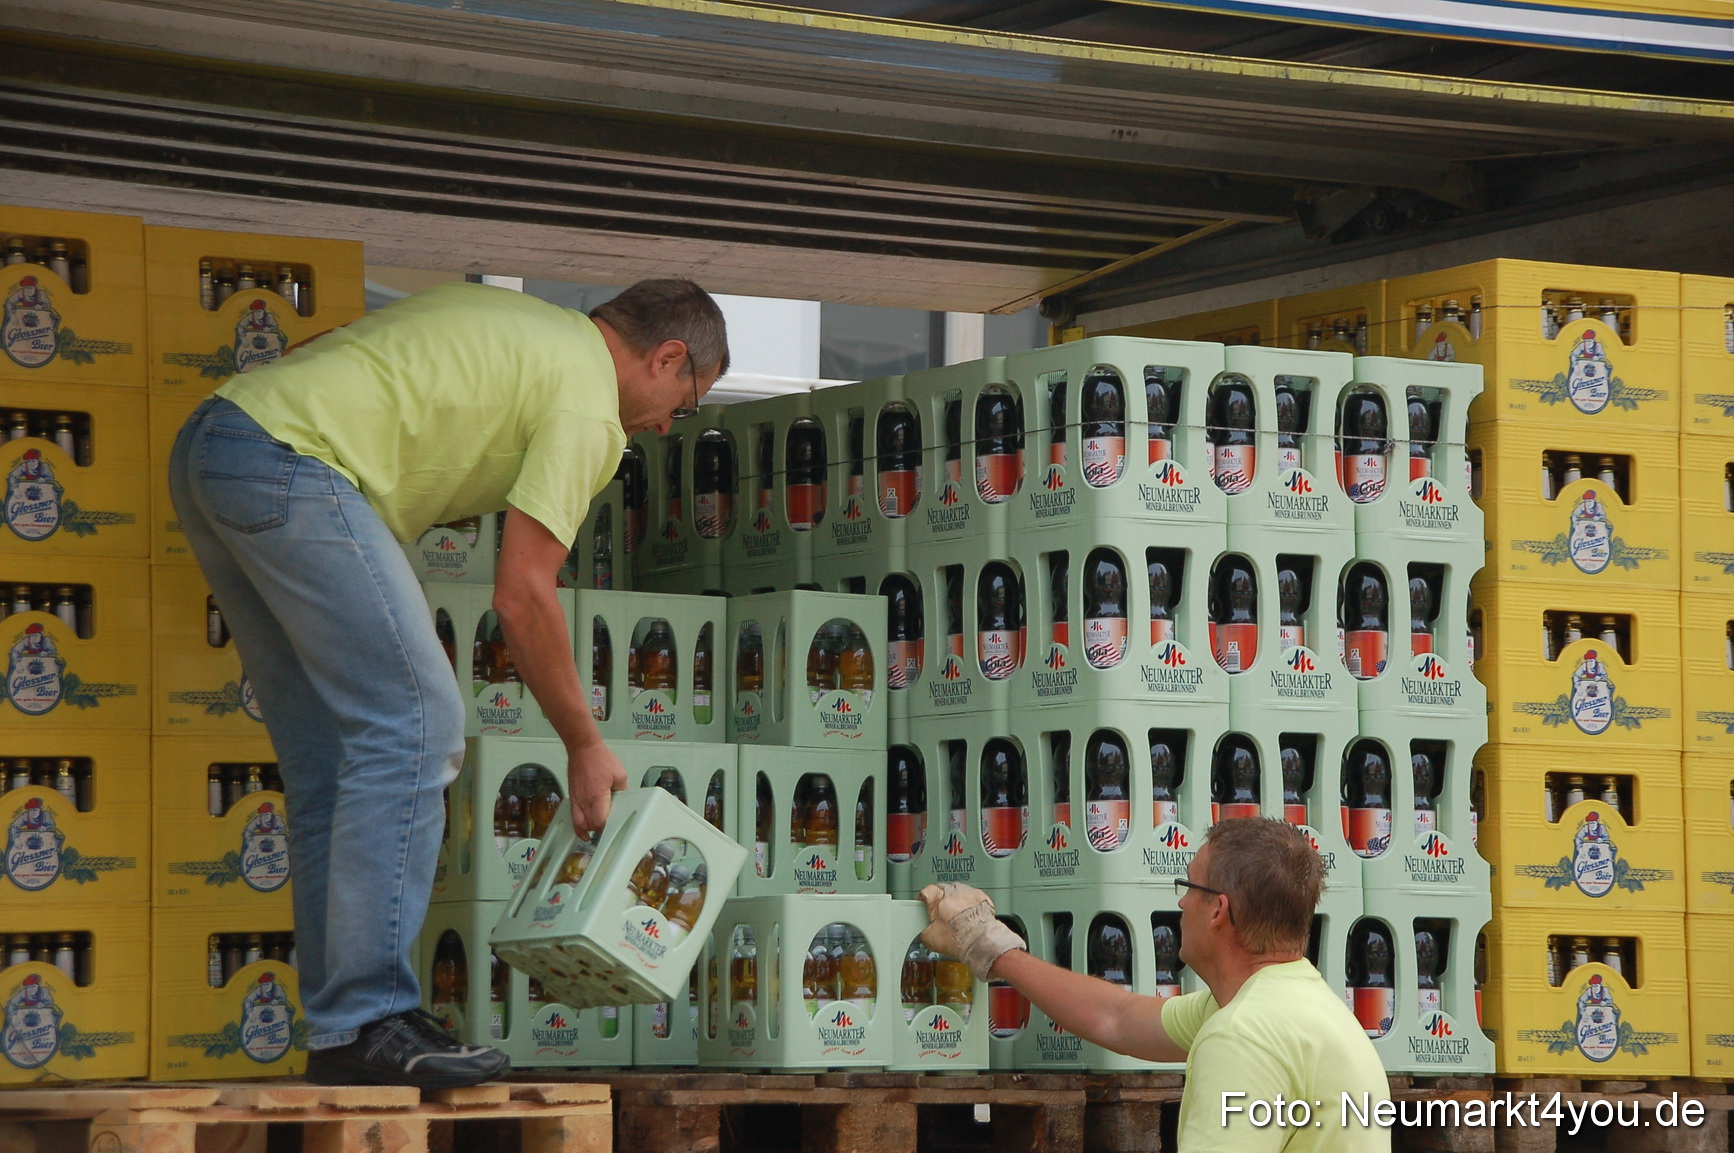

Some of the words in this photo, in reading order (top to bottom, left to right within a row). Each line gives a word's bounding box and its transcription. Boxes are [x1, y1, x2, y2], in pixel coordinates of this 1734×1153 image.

[32, 340, 54, 350] Bier
[1085, 465, 1104, 477] Cola
[1218, 473, 1239, 486] Cola
[1138, 484, 1201, 504] NEUMARKTER
[1359, 482, 1381, 495] Cola
[1030, 488, 1076, 510] NEUMARKTER
[1268, 492, 1329, 512] NEUMARKTER
[1035, 506, 1070, 518] MINERALBRUNNEN
[1145, 502, 1194, 513] MINERALBRUNNEN
[1399, 501, 1459, 521] NEUMARKTER
[34, 513, 57, 523] Bier
[927, 504, 970, 525] NEUMARKTER
[1275, 510, 1322, 520] MINERALBRUNNEN
[831, 518, 872, 539] NEUMARKTER
[932, 521, 965, 532] MINERALBRUNNEN
[1405, 519, 1452, 530] MINERALBRUNNEN
[836, 535, 868, 546] MINERALBRUNNEN
[423, 549, 468, 563] NEUMARKTER
[1088, 646, 1108, 660] Cola
[985, 658, 1007, 671] Cola
[1031, 668, 1078, 689] NEUMARKTER
[1140, 665, 1203, 685] NEUMARKTER
[1270, 670, 1332, 690] NEUMARKTER
[36, 686, 58, 697] Bier
[929, 679, 972, 699] NEUMARKTER
[1037, 685, 1073, 697] MINERALBRUNNEN
[1148, 683, 1196, 693] MINERALBRUNNEN
[1277, 688, 1325, 699] MINERALBRUNNEN
[1401, 677, 1462, 697] NEUMARKTER
[934, 696, 968, 706] MINERALBRUNNEN
[1408, 695, 1455, 706] MINERALBRUNNEN
[476, 706, 522, 719] NEUMARKTER
[632, 712, 676, 725] NEUMARKTER
[820, 711, 862, 725] NEUMARKTER
[931, 855, 975, 873] NEUMARKTER
[1033, 849, 1080, 869] NEUMARKTER
[1405, 855, 1465, 874] NEUMARKTER
[35, 861, 57, 872] Bier
[267, 863, 288, 874] Bier
[1039, 866, 1075, 877] MINERALBRUNNEN
[794, 868, 837, 882] NEUMARKTER
[937, 871, 971, 881] MINERALBRUNNEN
[1411, 873, 1458, 883] MINERALBRUNNEN
[268, 1034, 288, 1045] Bier
[532, 1028, 579, 1041] NEUMARKTER
[818, 1027, 866, 1040] NEUMARKTER
[916, 1030, 962, 1043] NEUMARKTER
[32, 1038, 54, 1049] Bier
[1036, 1034, 1082, 1051] NEUMARKTER
[1408, 1036, 1470, 1054] NEUMARKTER
[1042, 1050, 1078, 1061] MINERALBRUNNEN
[1415, 1054, 1463, 1063] MINERALBRUNNEN
